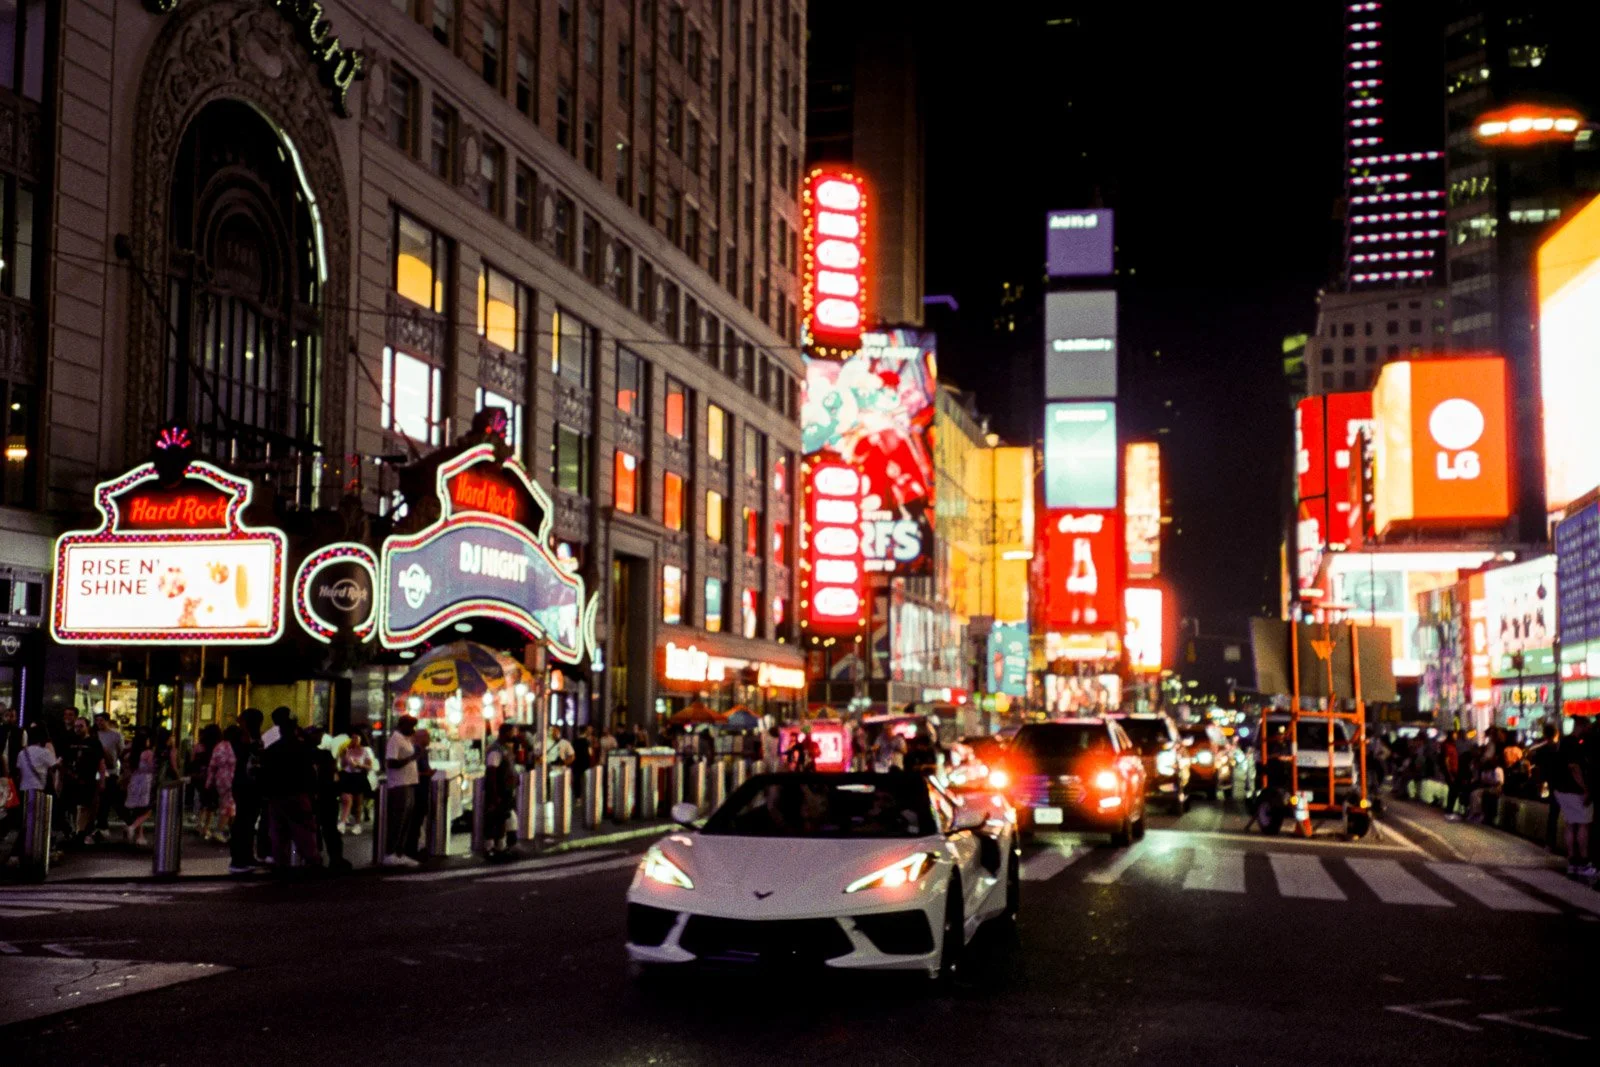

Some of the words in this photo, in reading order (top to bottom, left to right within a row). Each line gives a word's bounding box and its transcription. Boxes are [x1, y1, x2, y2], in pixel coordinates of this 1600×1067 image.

[1437, 450, 1481, 480] LG
[456, 473, 487, 506] Hard
[487, 482, 516, 516] Rock
[130, 496, 183, 522] Hard
[184, 496, 227, 524] Rock
[81, 559, 130, 575] RISE
[140, 559, 160, 574] N'
[459, 541, 481, 574] DJ
[481, 546, 529, 583] NIGHT
[80, 579, 148, 596] SHINE
